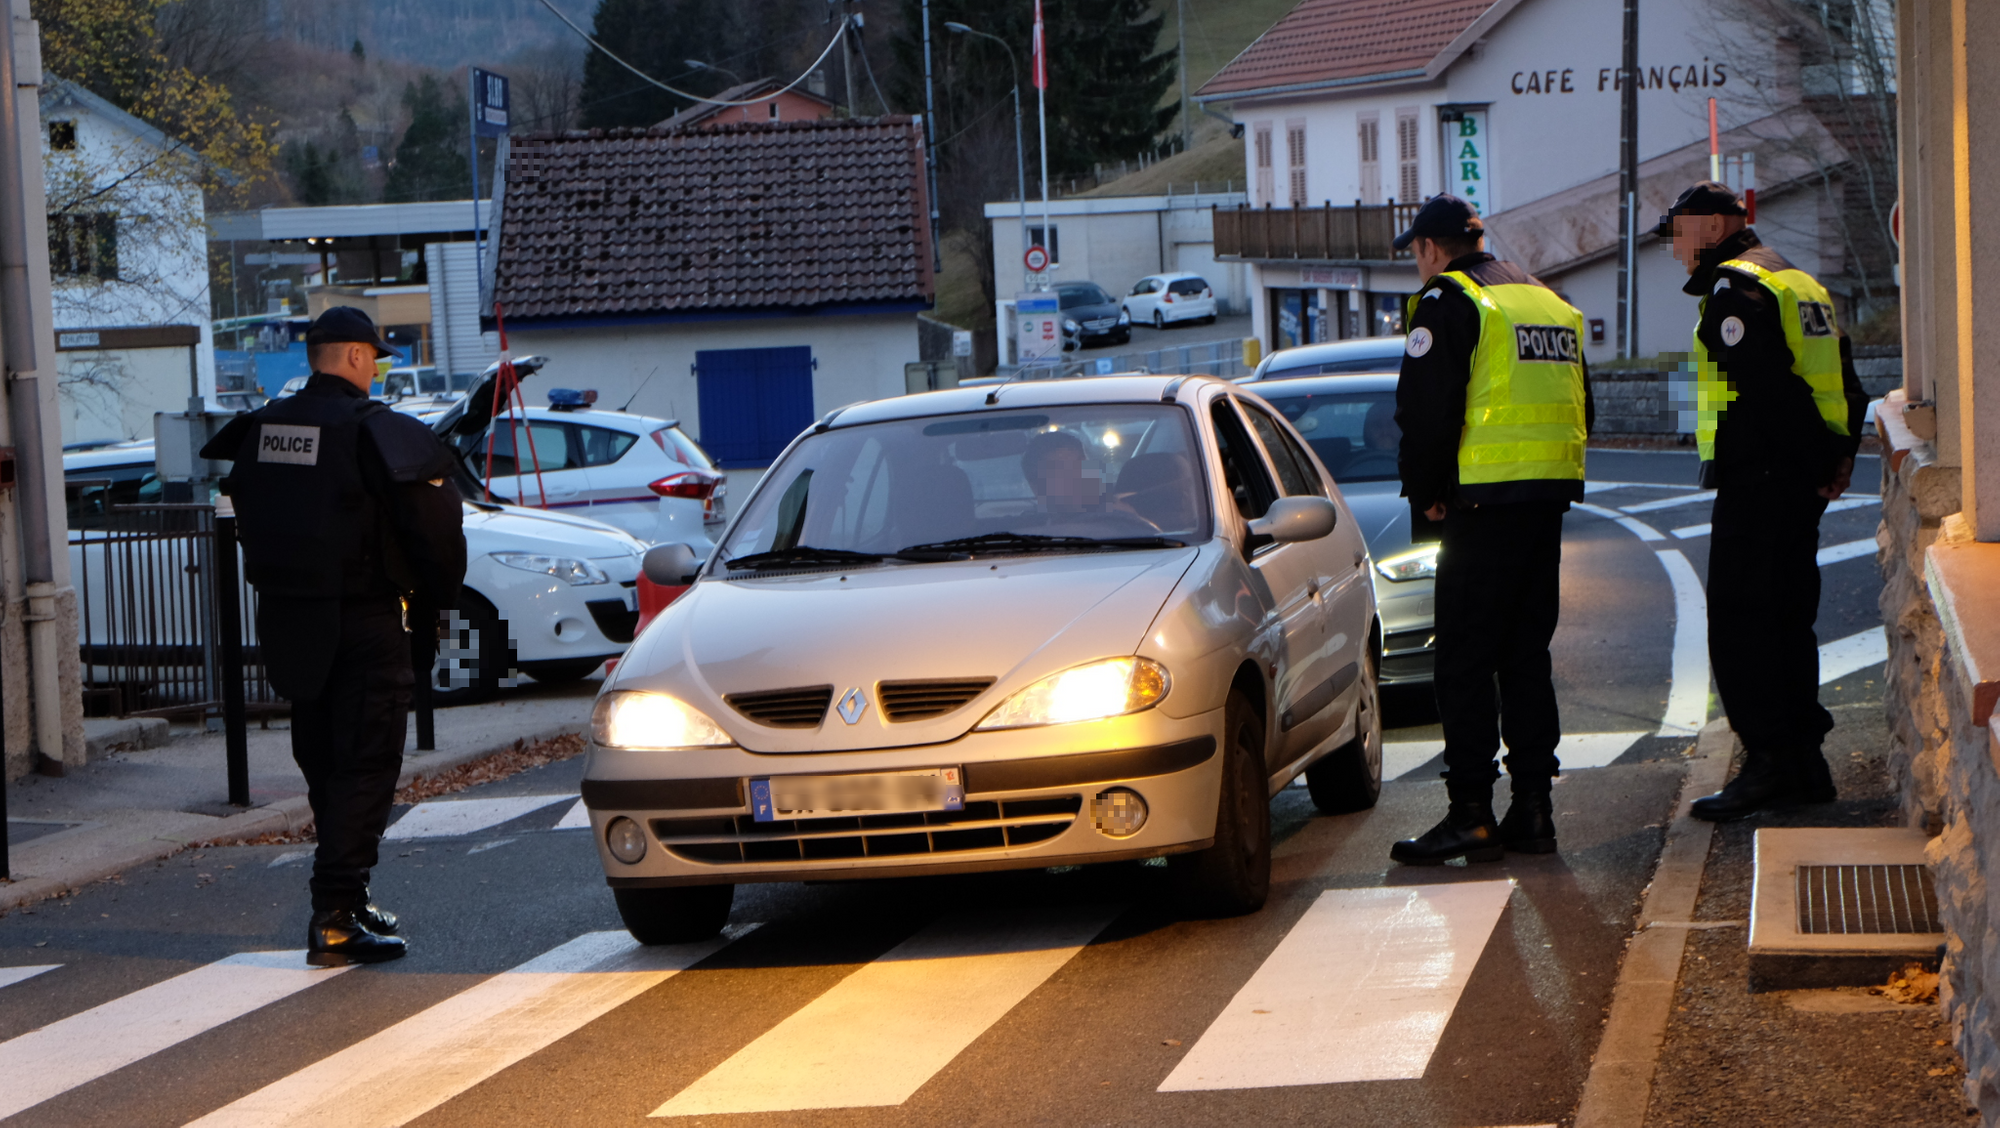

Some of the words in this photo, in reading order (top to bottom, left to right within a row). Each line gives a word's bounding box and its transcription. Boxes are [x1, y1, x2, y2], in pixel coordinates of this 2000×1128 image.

[1458, 117, 1481, 181] BAR
[1518, 329, 1577, 359] POLICE
[263, 435, 314, 454] POLICE
[759, 804, 768, 815] F
